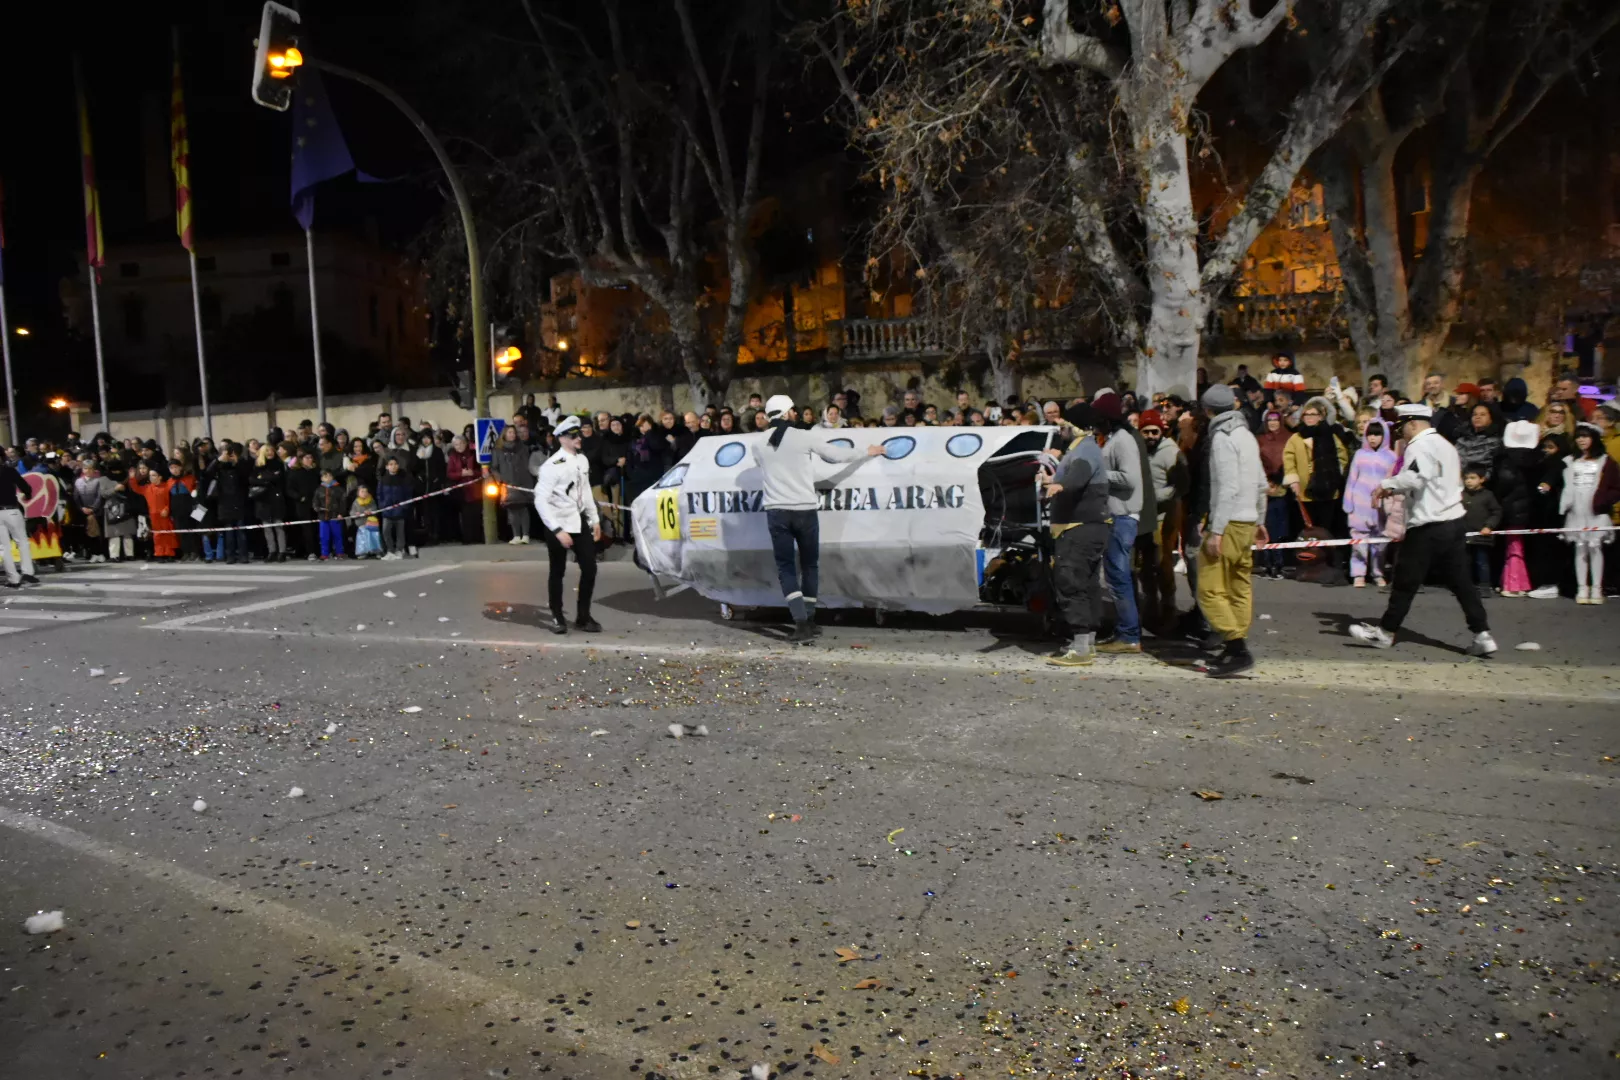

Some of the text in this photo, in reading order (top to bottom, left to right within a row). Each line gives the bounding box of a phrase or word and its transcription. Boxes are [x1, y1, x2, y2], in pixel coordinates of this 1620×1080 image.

[659, 496, 676, 530] 16
[686, 490, 767, 514] FUERZ
[885, 484, 965, 510] ARAG
